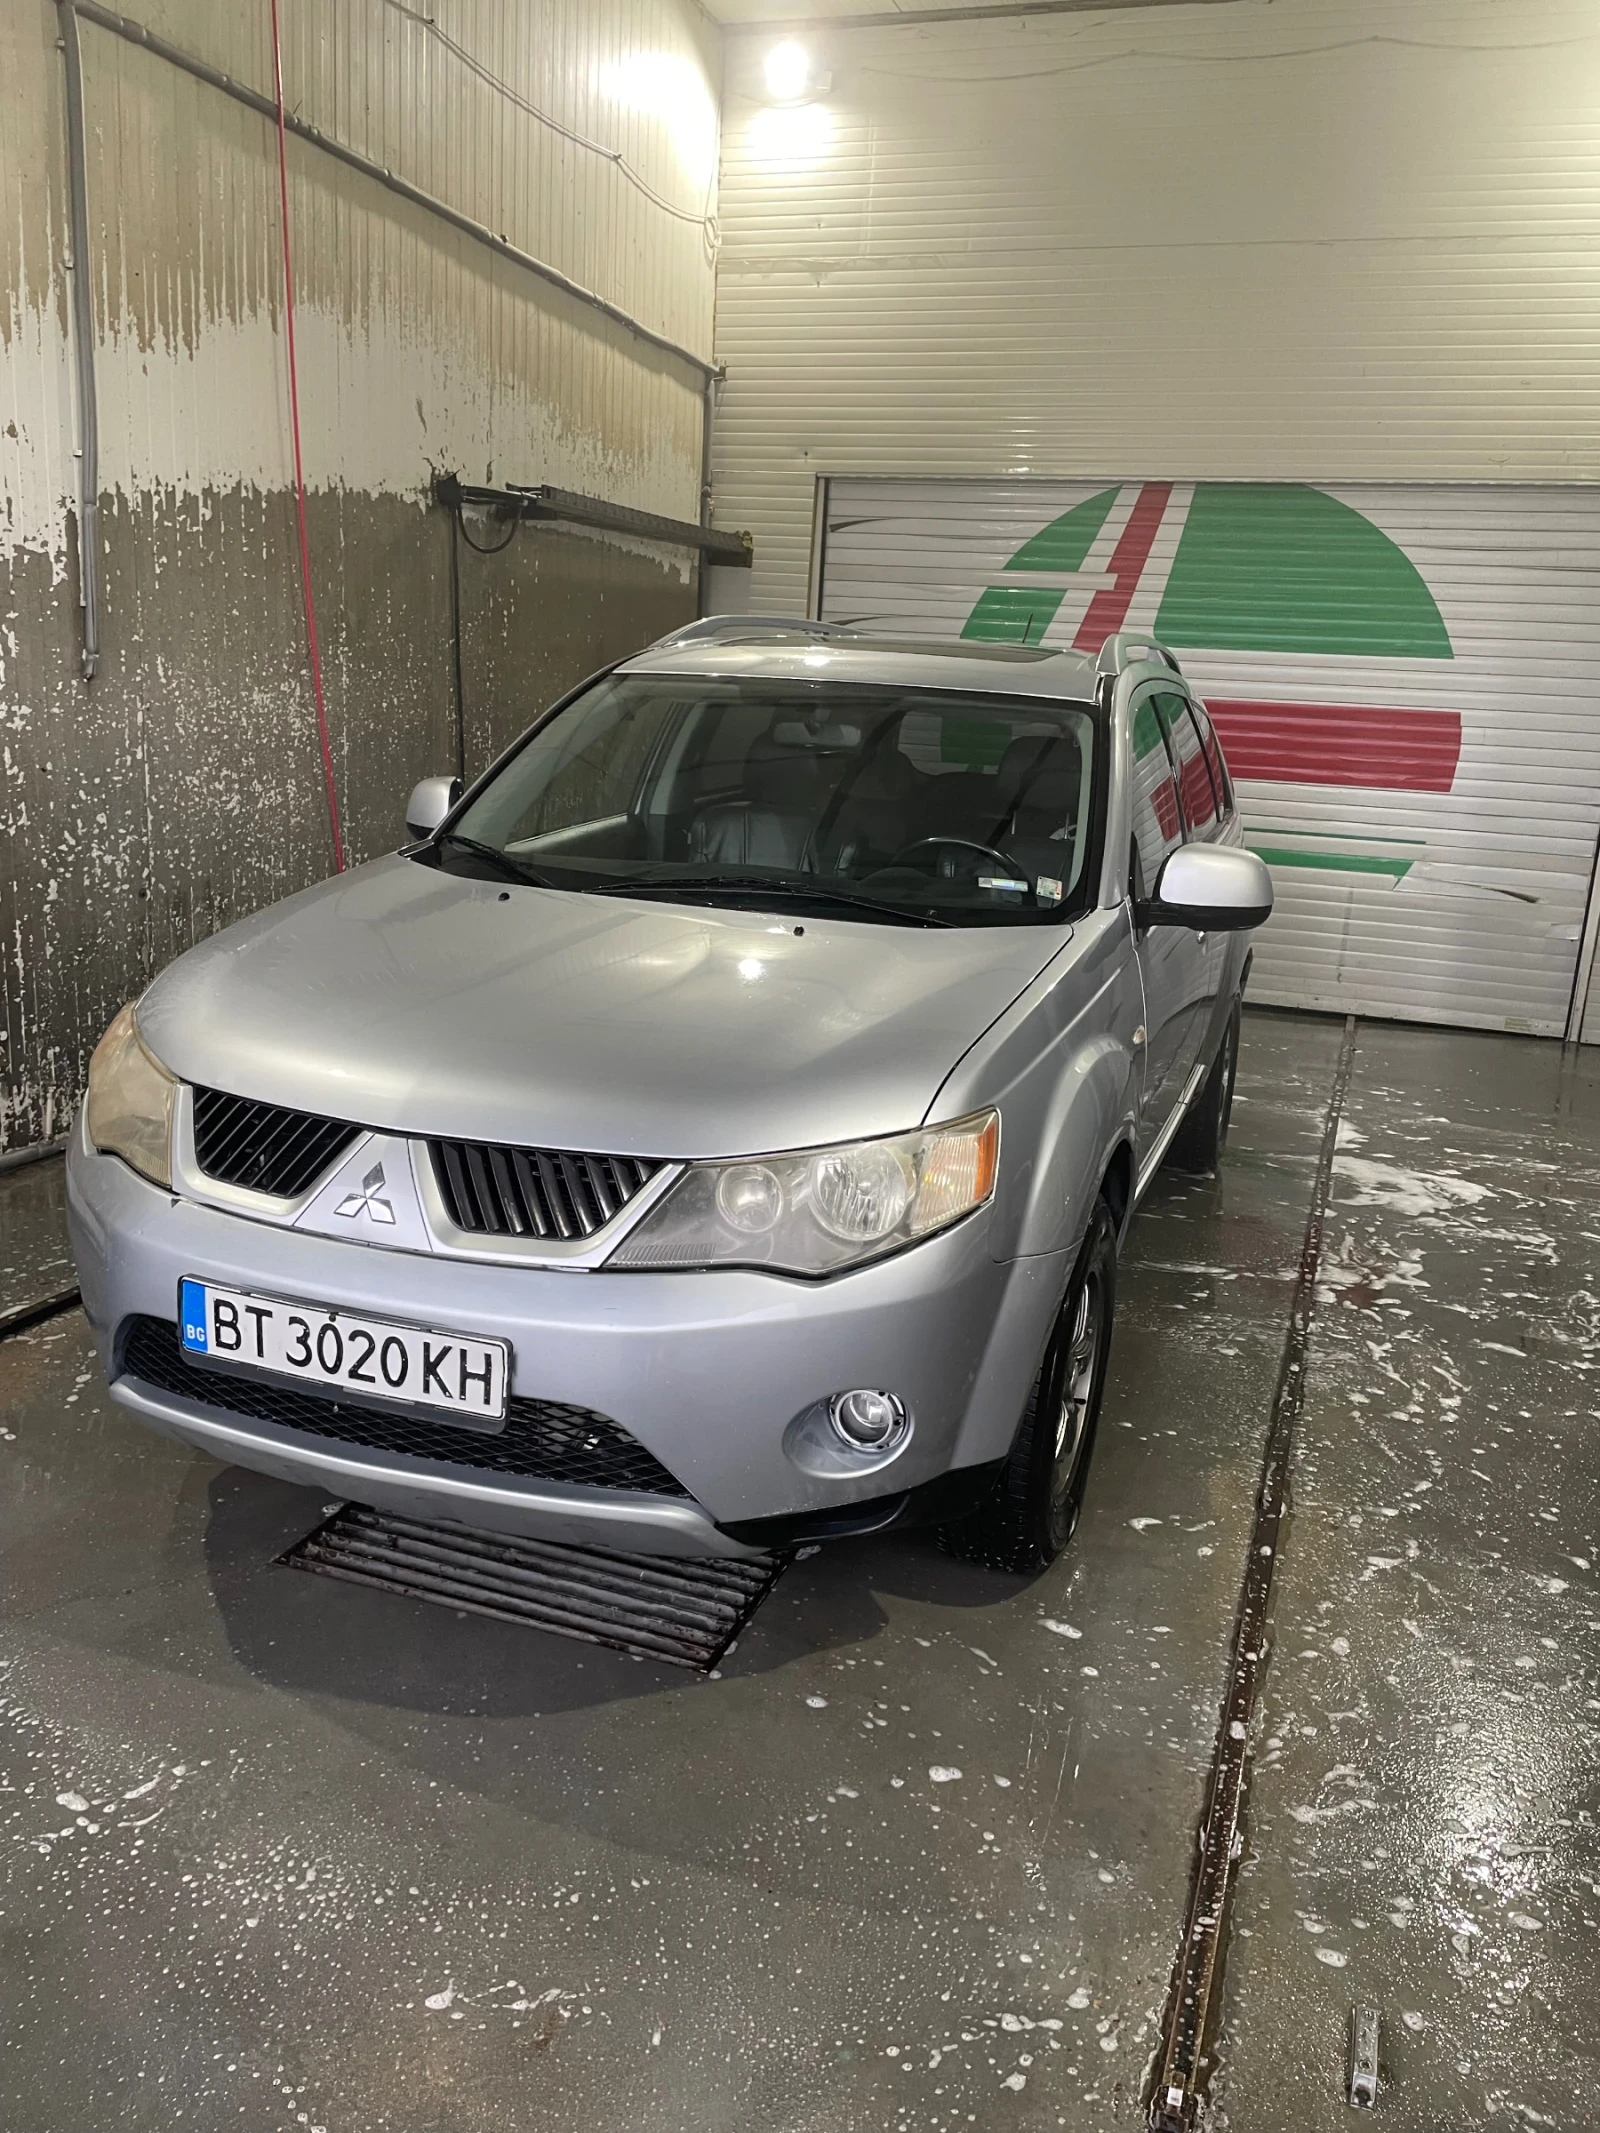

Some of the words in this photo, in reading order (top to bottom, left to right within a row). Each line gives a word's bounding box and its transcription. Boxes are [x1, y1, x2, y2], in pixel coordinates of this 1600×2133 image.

[186, 1323, 206, 1342] BG
[213, 1298, 273, 1358] BT
[286, 1316, 409, 1388] 3020
[423, 1341, 492, 1405] KH
